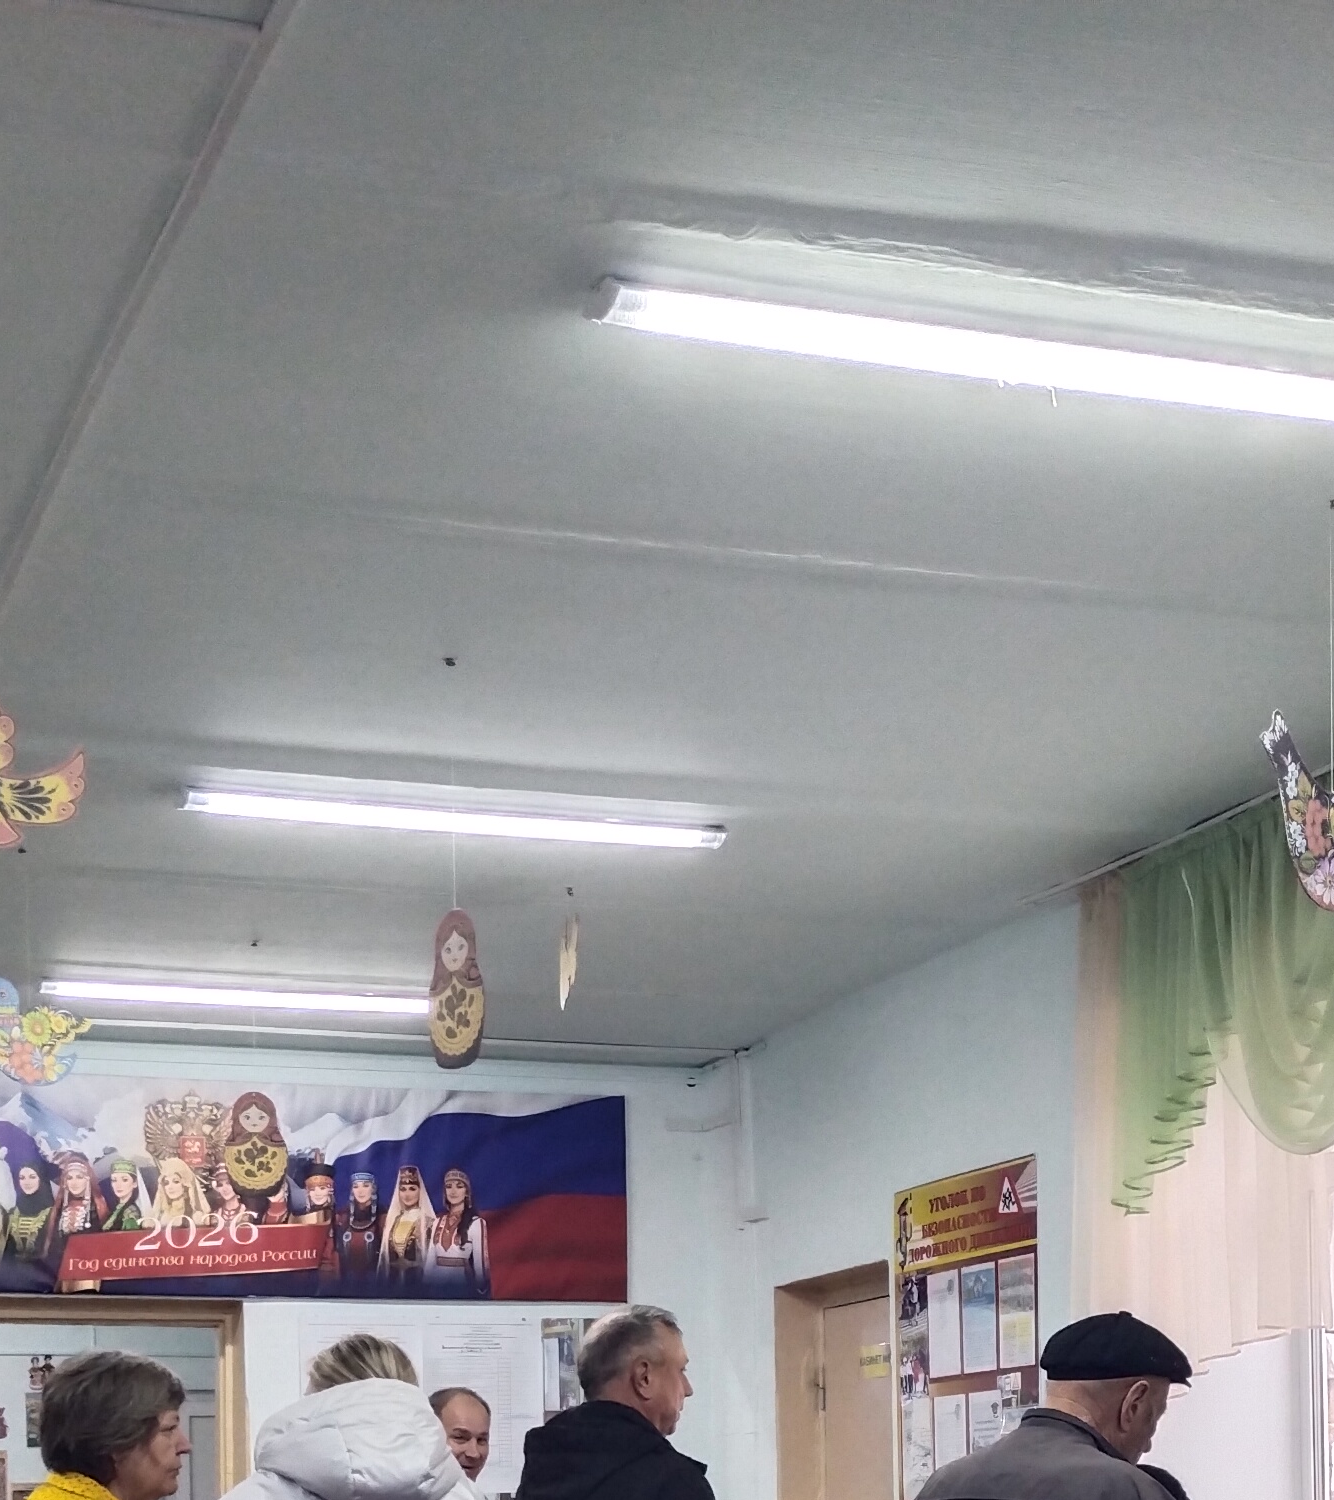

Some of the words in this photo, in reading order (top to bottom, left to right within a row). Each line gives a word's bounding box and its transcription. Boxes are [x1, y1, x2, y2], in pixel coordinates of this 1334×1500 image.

[134, 1211, 259, 1250] 2026
[69, 1257, 100, 1272] Год
[104, 1255, 185, 1271] единства
[190, 1252, 259, 1268] народов
[261, 1248, 318, 1263] России
